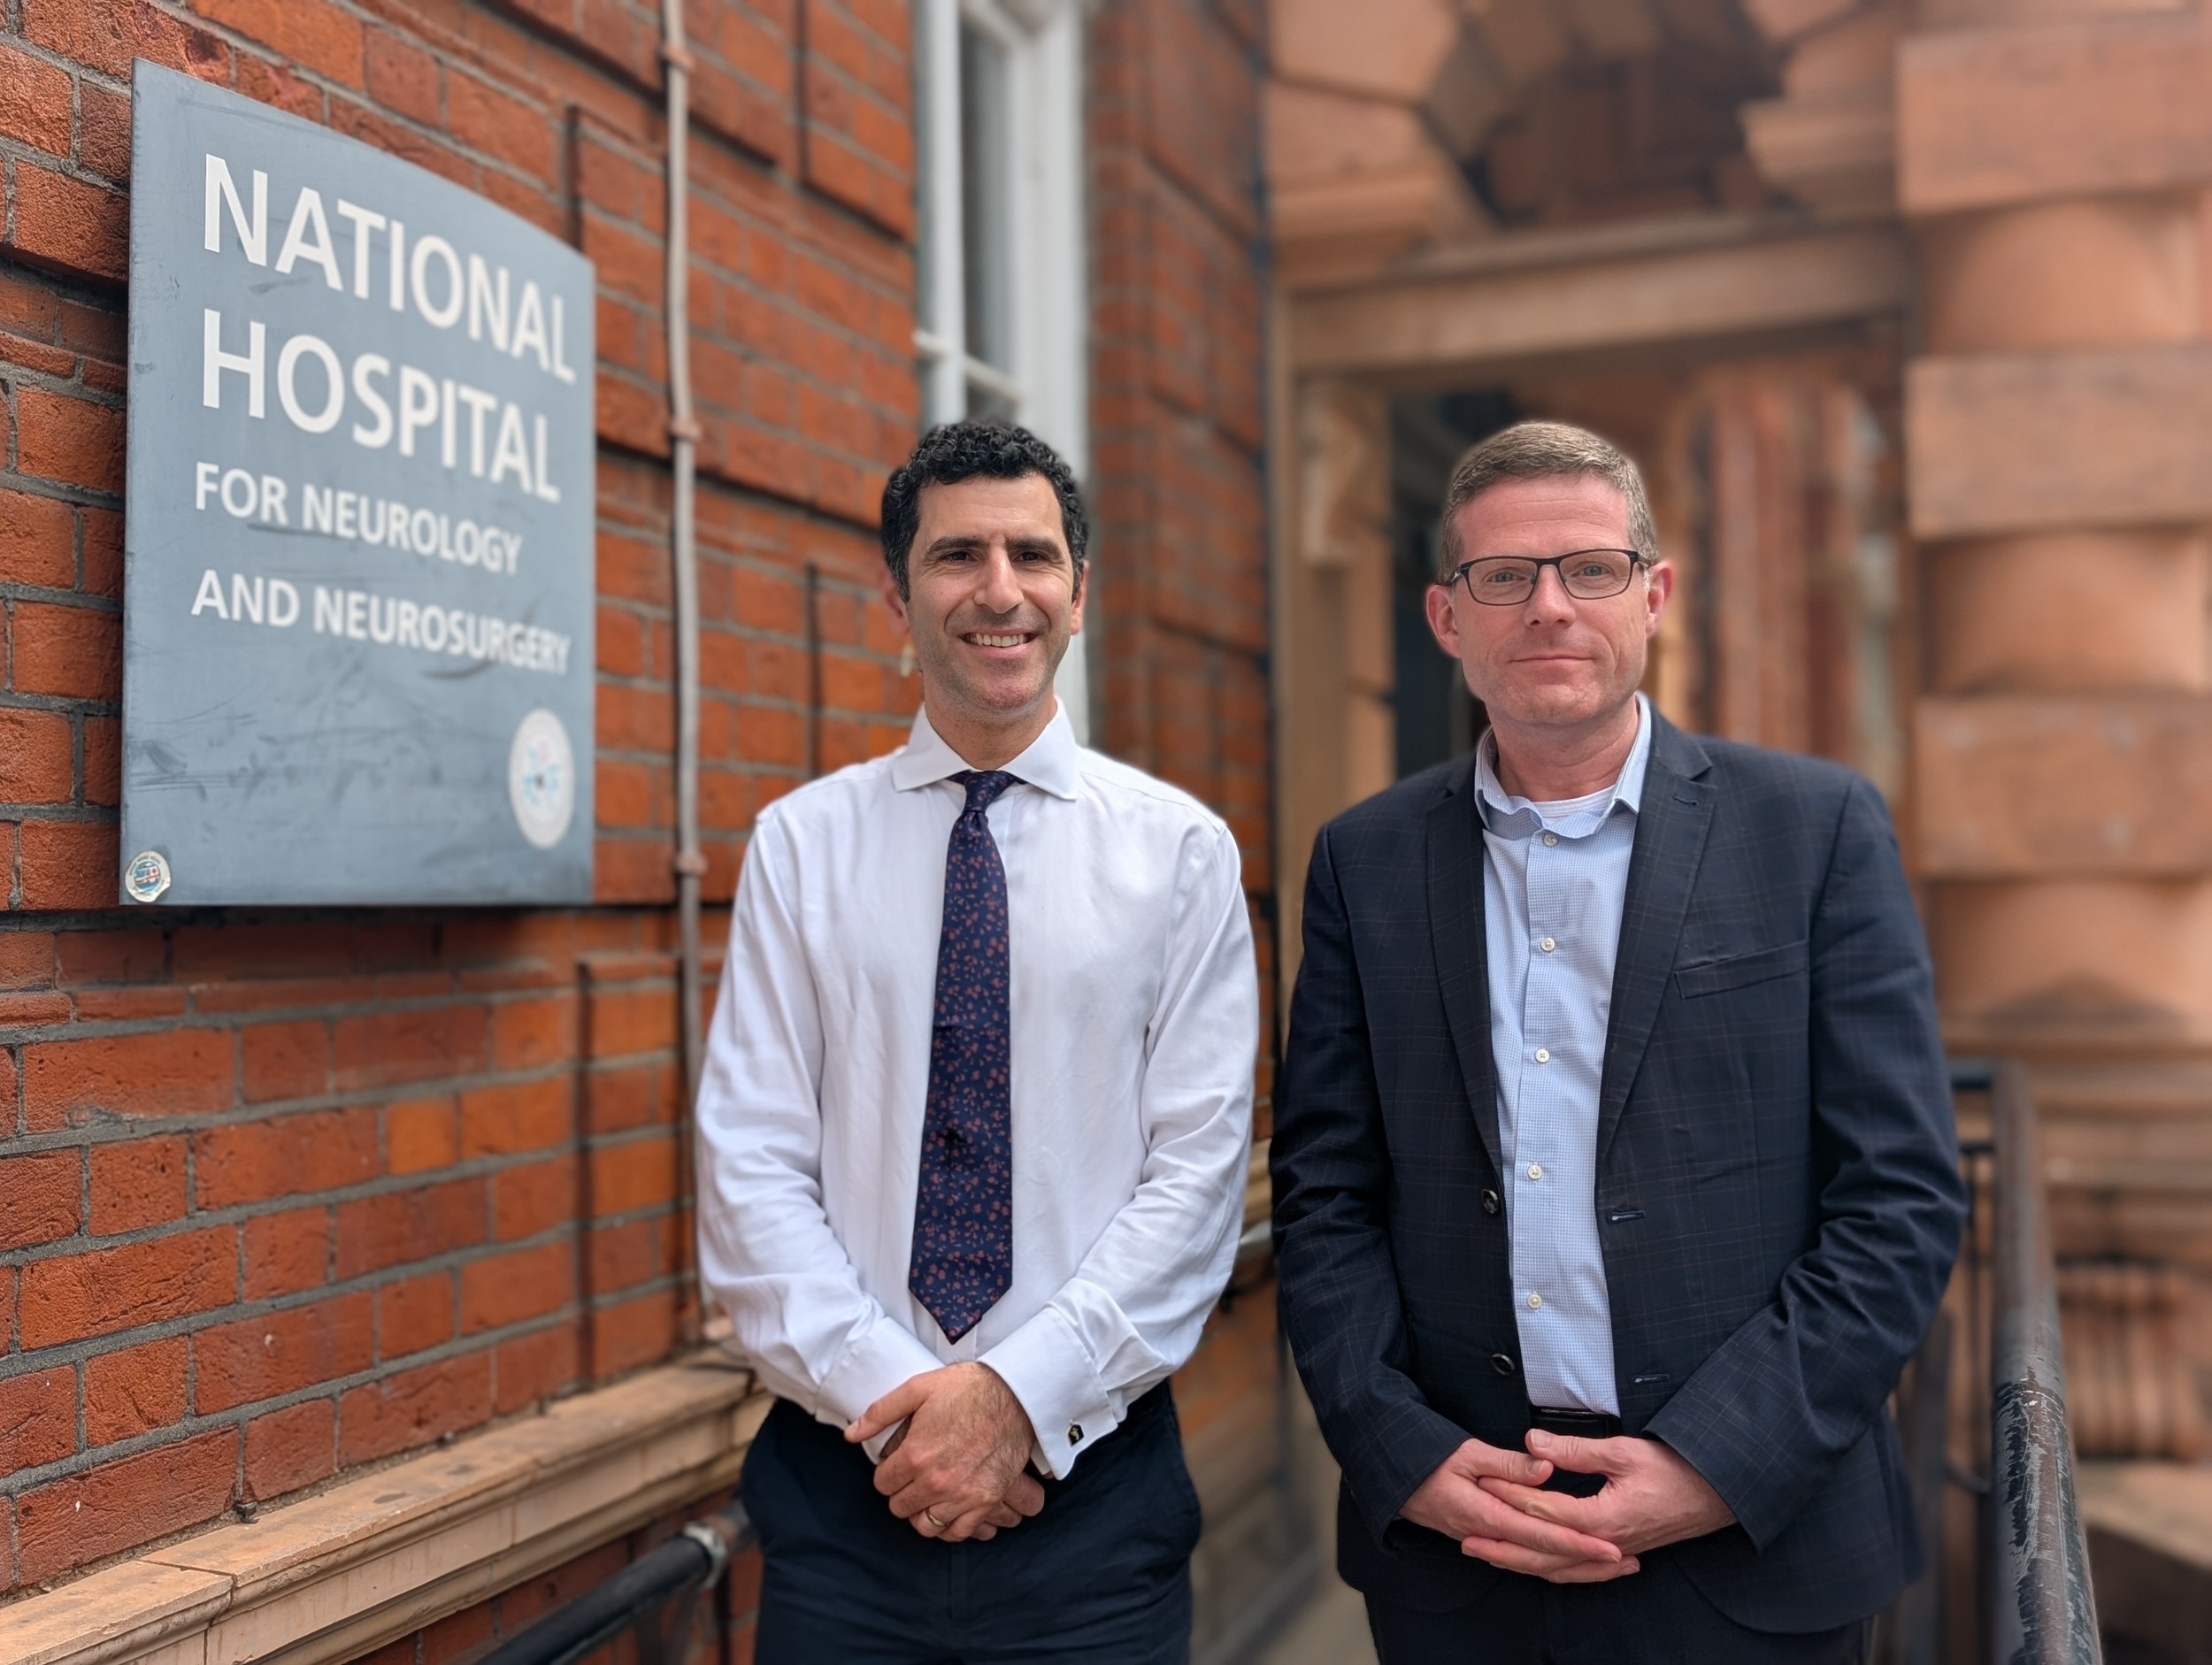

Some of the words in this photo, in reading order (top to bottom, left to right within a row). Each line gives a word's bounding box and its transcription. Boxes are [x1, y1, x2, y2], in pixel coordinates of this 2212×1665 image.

[204, 153, 577, 384] NATIONAL
[203, 308, 562, 504] HOSPITAL
[195, 461, 288, 526] FOR
[302, 483, 523, 576] NEUROLOGY
[190, 569, 301, 627] AND
[313, 587, 571, 674] NEUROSURGERY
